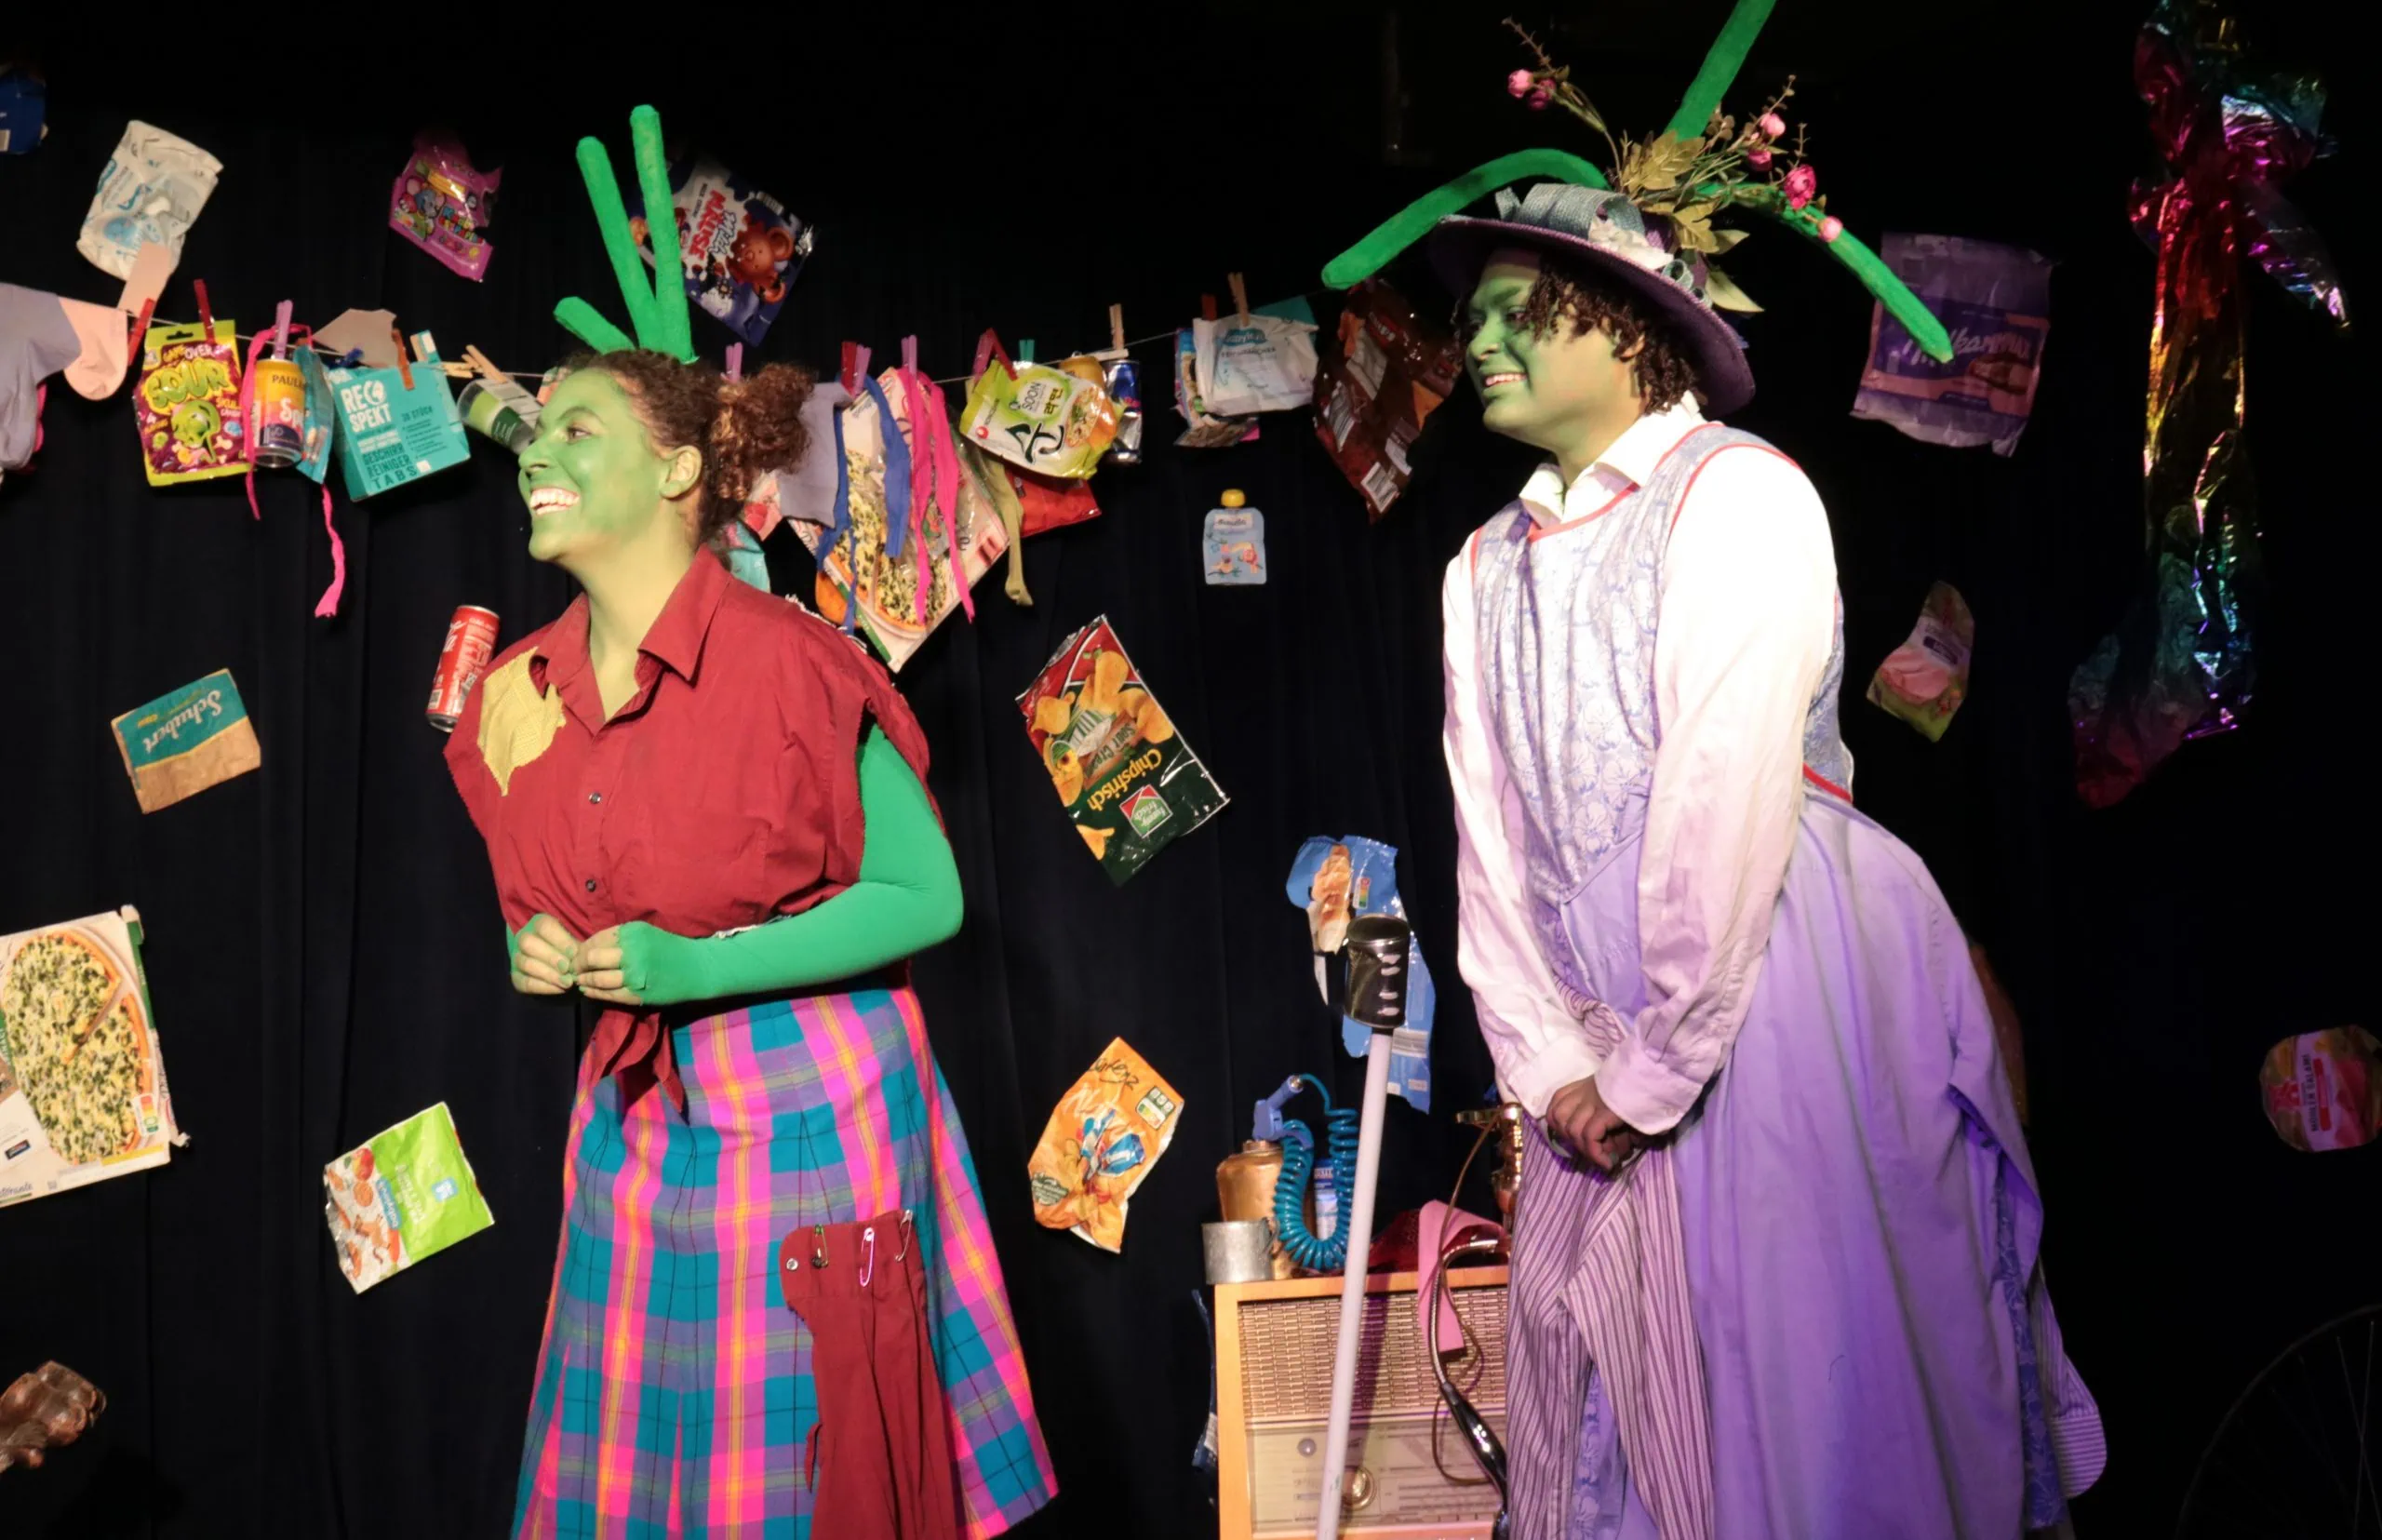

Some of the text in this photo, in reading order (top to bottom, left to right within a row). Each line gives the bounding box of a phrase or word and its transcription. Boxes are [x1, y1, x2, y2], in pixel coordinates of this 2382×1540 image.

[185, 343, 213, 359] OVER
[147, 358, 229, 408] SOUR
[1023, 382, 1041, 410] SOON
[350, 403, 392, 433] SPEKT
[363, 443, 405, 465] GESCHIRR
[367, 454, 413, 478] REINIGER
[373, 465, 418, 489] TABS
[141, 690, 221, 754] Schubert
[1086, 749, 1162, 811] Chipsfrisch
